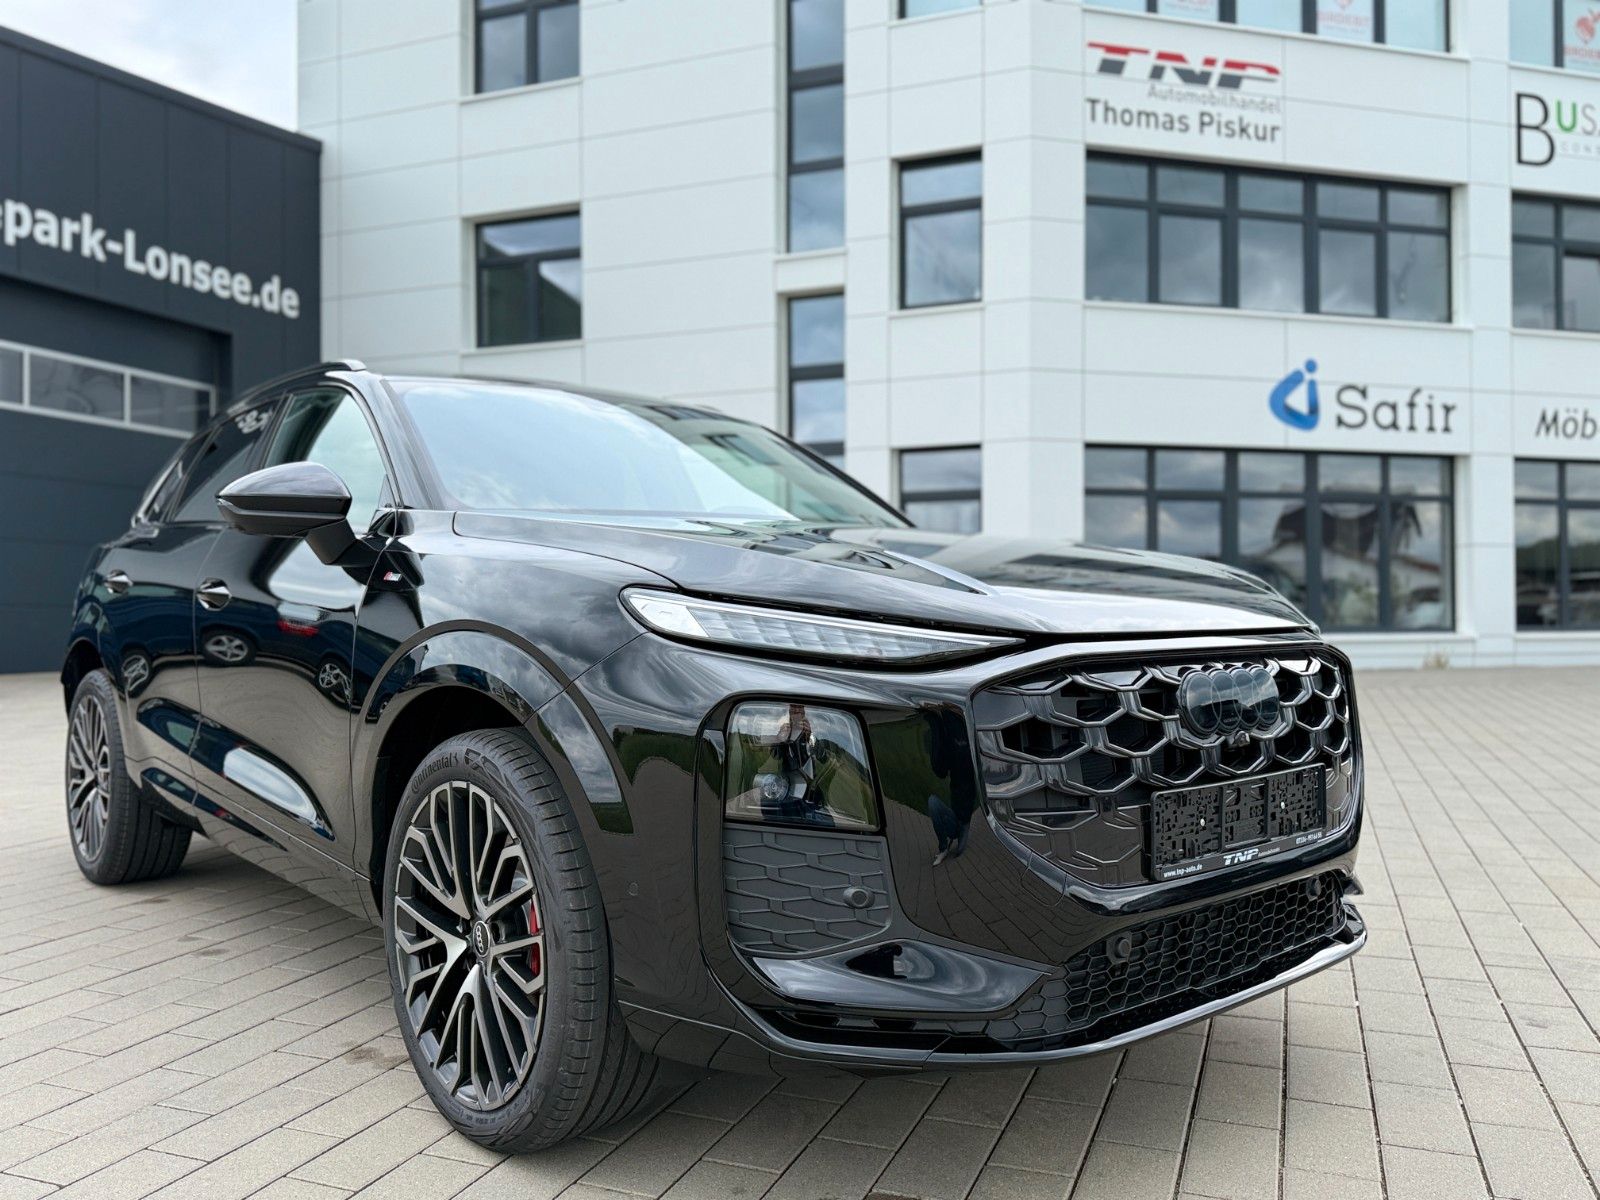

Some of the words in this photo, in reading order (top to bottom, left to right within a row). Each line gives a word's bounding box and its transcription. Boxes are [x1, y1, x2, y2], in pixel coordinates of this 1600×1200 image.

[1087, 41, 1280, 90] TNP
[1086, 98, 1190, 133] Thomas
[1198, 110, 1281, 143] Piskur
[1515, 91, 1600, 168] BUS
[0, 198, 300, 319] park-Lonsee.de
[1335, 384, 1457, 433] Safir
[411, 752, 453, 794] Continental
[1223, 848, 1259, 865] TNP
